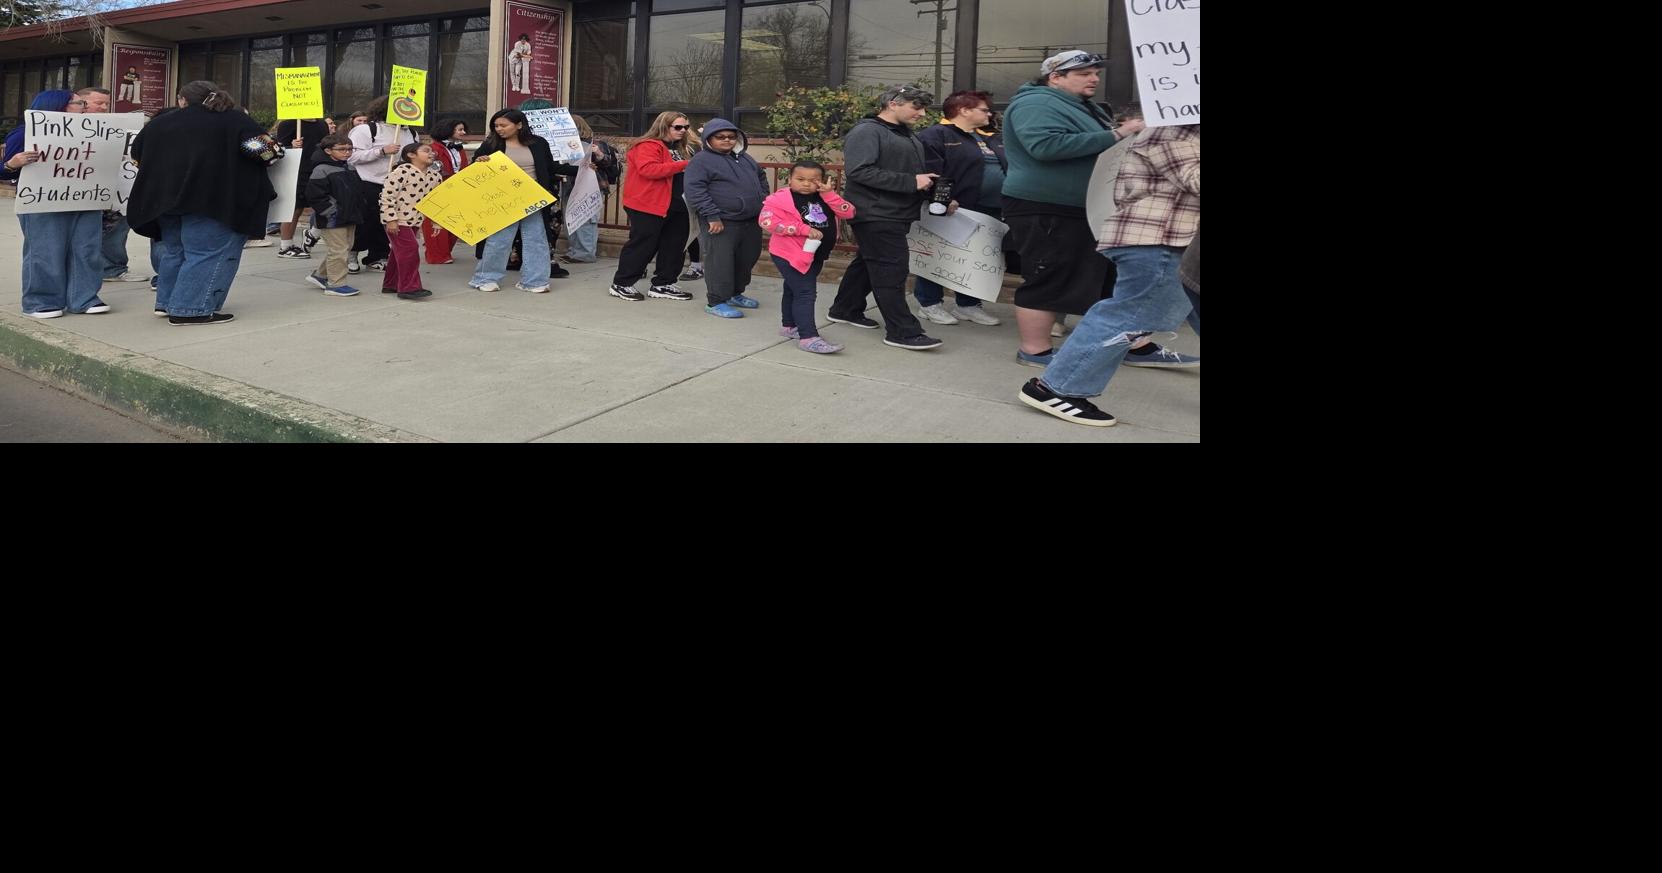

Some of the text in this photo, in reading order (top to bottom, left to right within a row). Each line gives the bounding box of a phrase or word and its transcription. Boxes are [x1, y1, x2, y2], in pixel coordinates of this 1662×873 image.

[516, 8, 555, 23] Citizenship
[1135, 41, 1191, 66] my
[1147, 74, 1178, 91] is
[30, 111, 125, 141] Pink Slips
[53, 162, 95, 180] help
[18, 183, 111, 205] Students
[524, 199, 549, 215] ABCD
[907, 237, 935, 252] OSE
[938, 250, 968, 264] your
[913, 254, 928, 269] for
